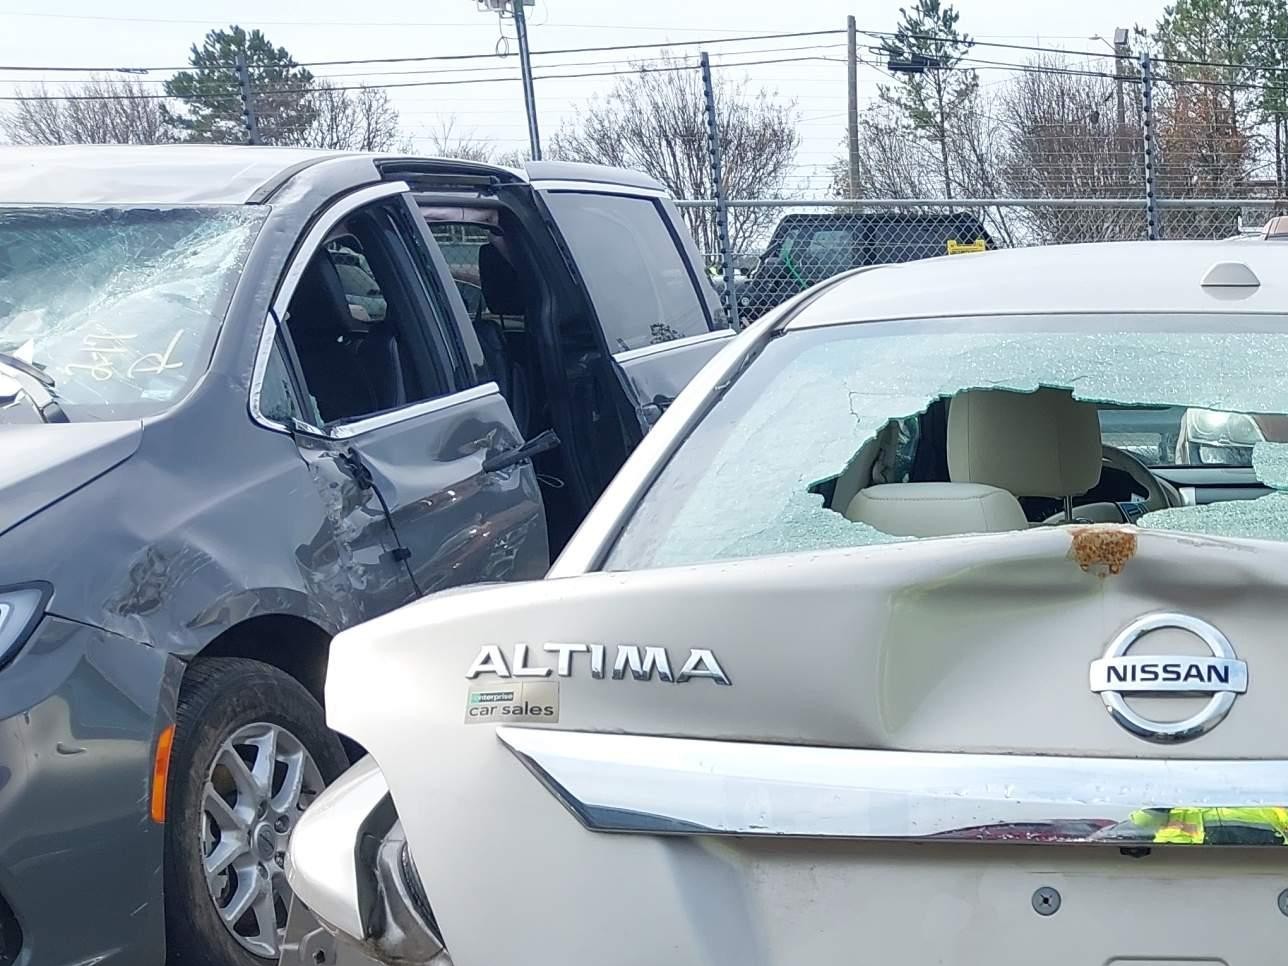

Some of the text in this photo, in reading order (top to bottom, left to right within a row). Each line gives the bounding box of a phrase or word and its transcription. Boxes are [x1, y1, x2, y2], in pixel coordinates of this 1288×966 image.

[465, 642, 732, 686] ALTIMA
[1107, 664, 1229, 683] NISSAN
[469, 700, 554, 716] car sales
